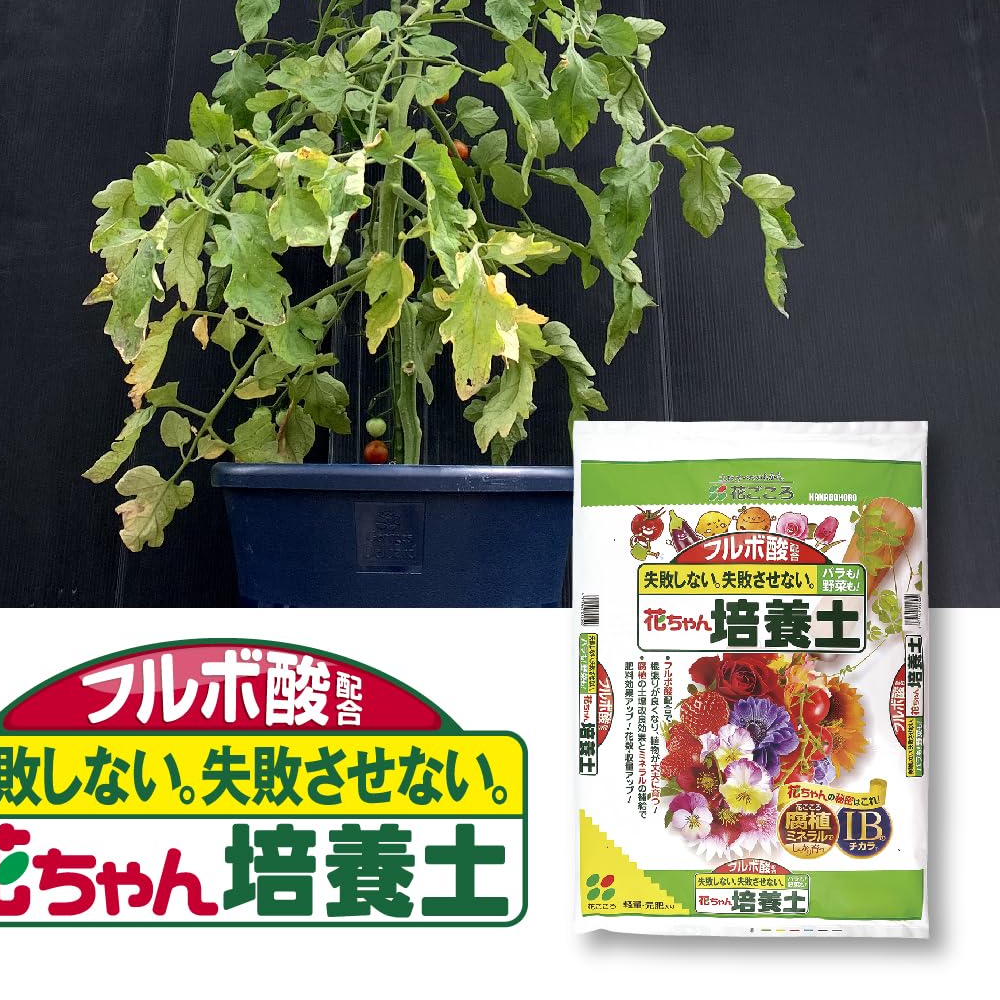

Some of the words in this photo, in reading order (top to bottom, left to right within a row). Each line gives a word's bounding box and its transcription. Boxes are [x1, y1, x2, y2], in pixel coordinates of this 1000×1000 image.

[704, 536, 788, 561] フルボ酸
[644, 570, 815, 589] 失敗しない。失敗させない。
[822, 579, 860, 592] 野菜も!
[785, 811, 832, 830] 腐植
